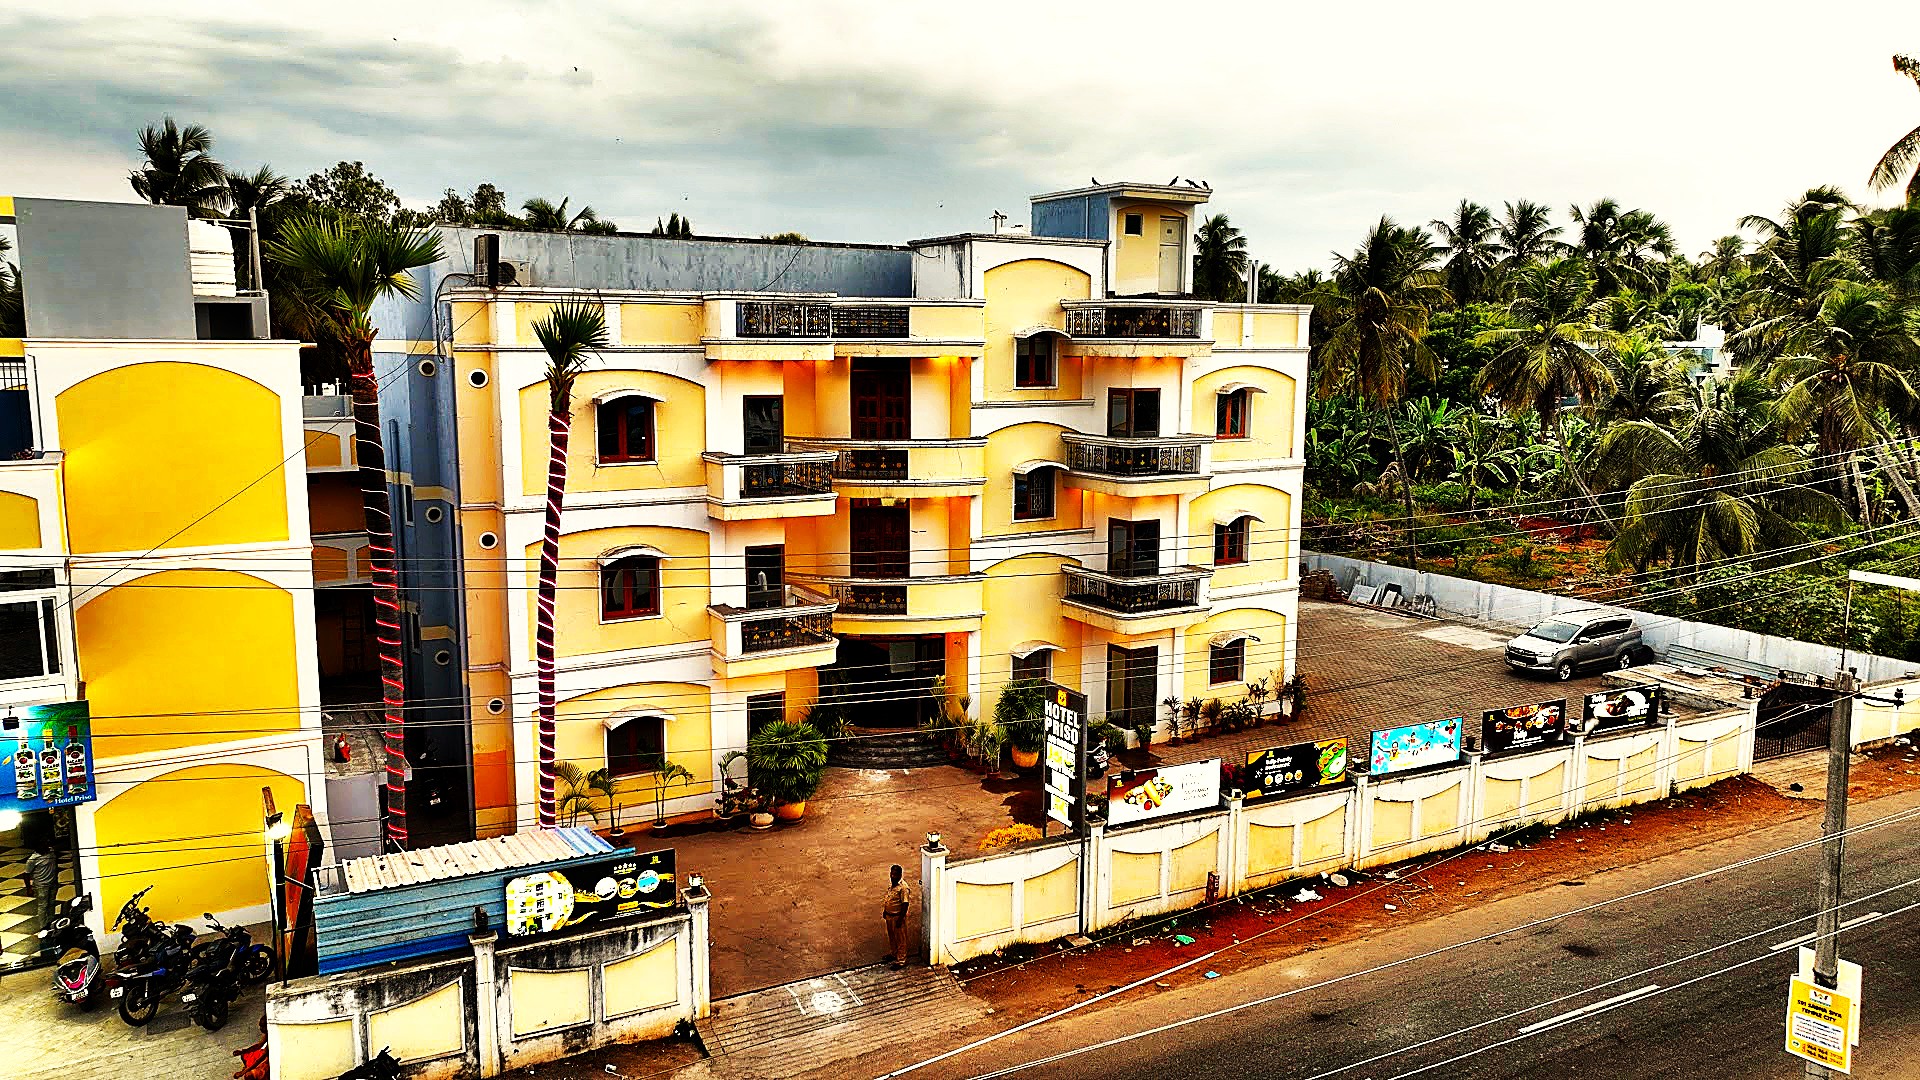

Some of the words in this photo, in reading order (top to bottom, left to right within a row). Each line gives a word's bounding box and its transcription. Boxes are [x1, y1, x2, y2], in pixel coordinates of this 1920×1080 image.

[1045, 699, 1080, 730] HOTEL
[1044, 715, 1079, 745] PRISO
[55, 796, 74, 804] Hotel
[1823, 1014, 1837, 1022] CITY
